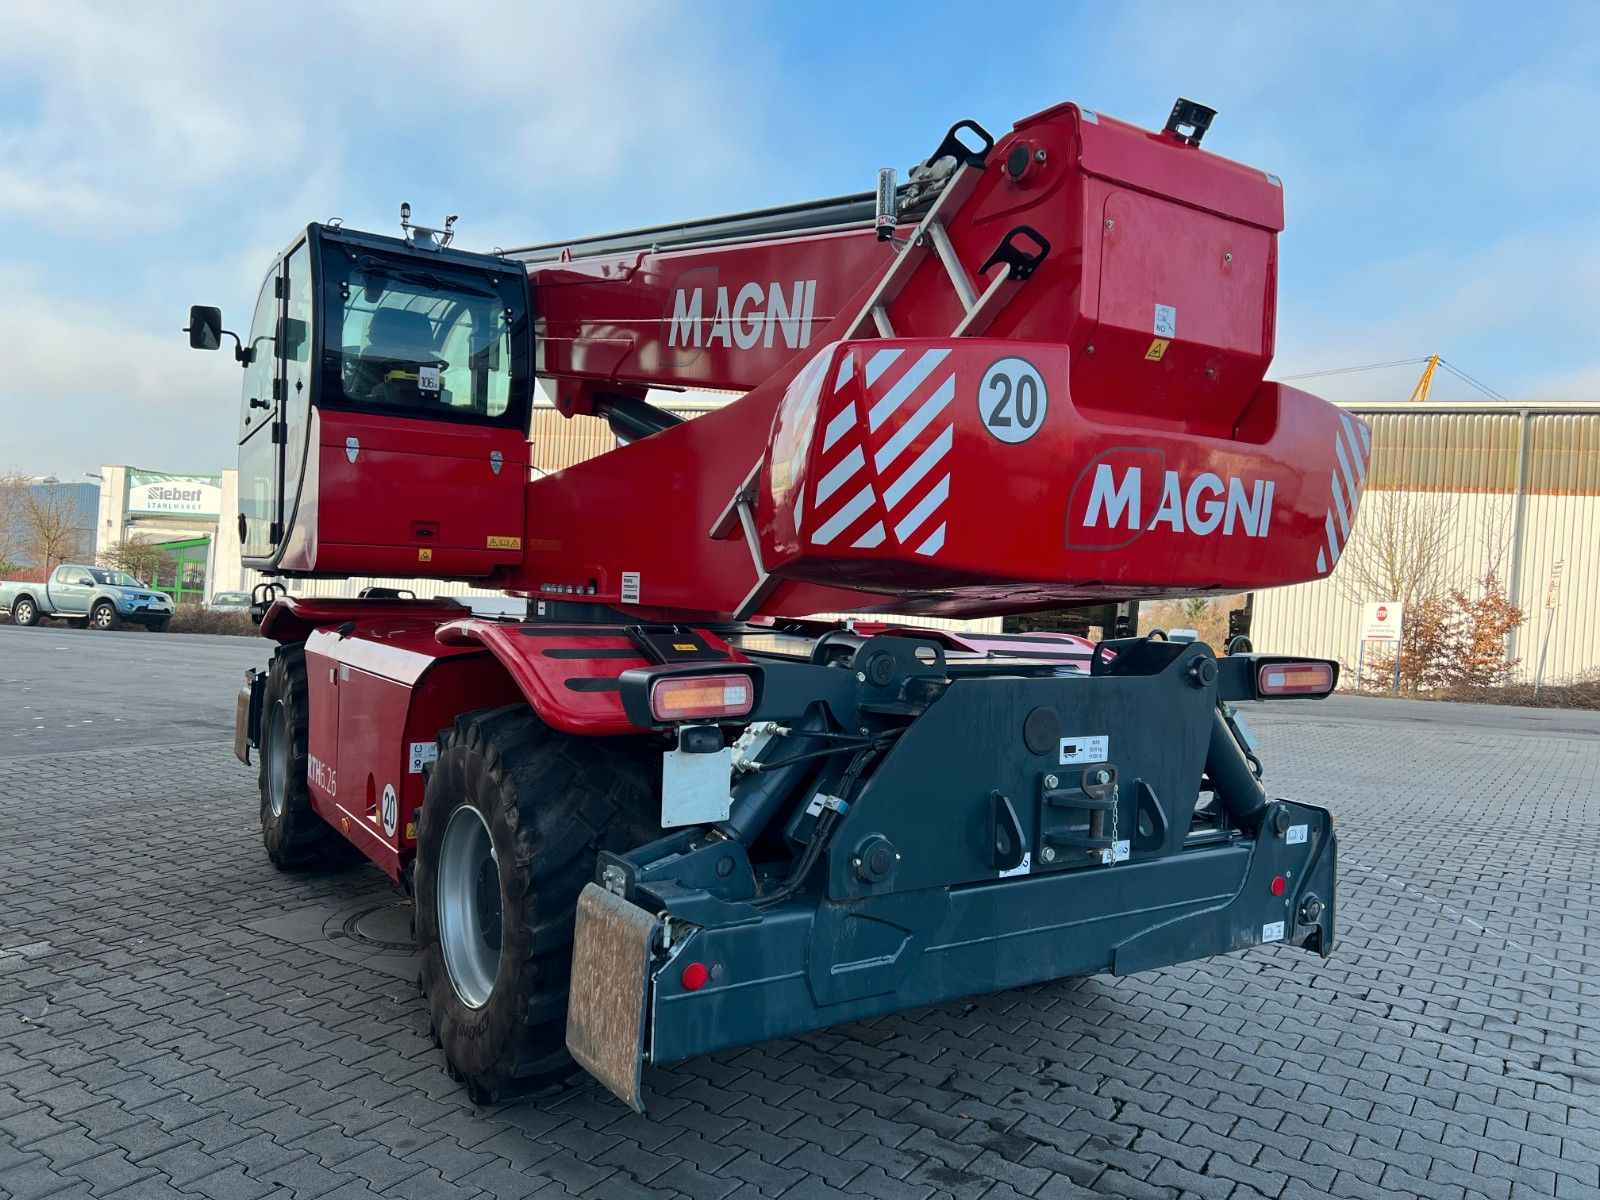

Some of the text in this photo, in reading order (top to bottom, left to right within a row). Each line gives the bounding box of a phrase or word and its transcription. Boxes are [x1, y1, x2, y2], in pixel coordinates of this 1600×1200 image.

[667, 279, 817, 350] MAGNI
[988, 372, 1038, 429] 20
[146, 502, 202, 511] STAHLMARKT
[147, 486, 203, 502] Siebert
[1082, 463, 1276, 538] MAGNI
[383, 791, 396, 830] 20
